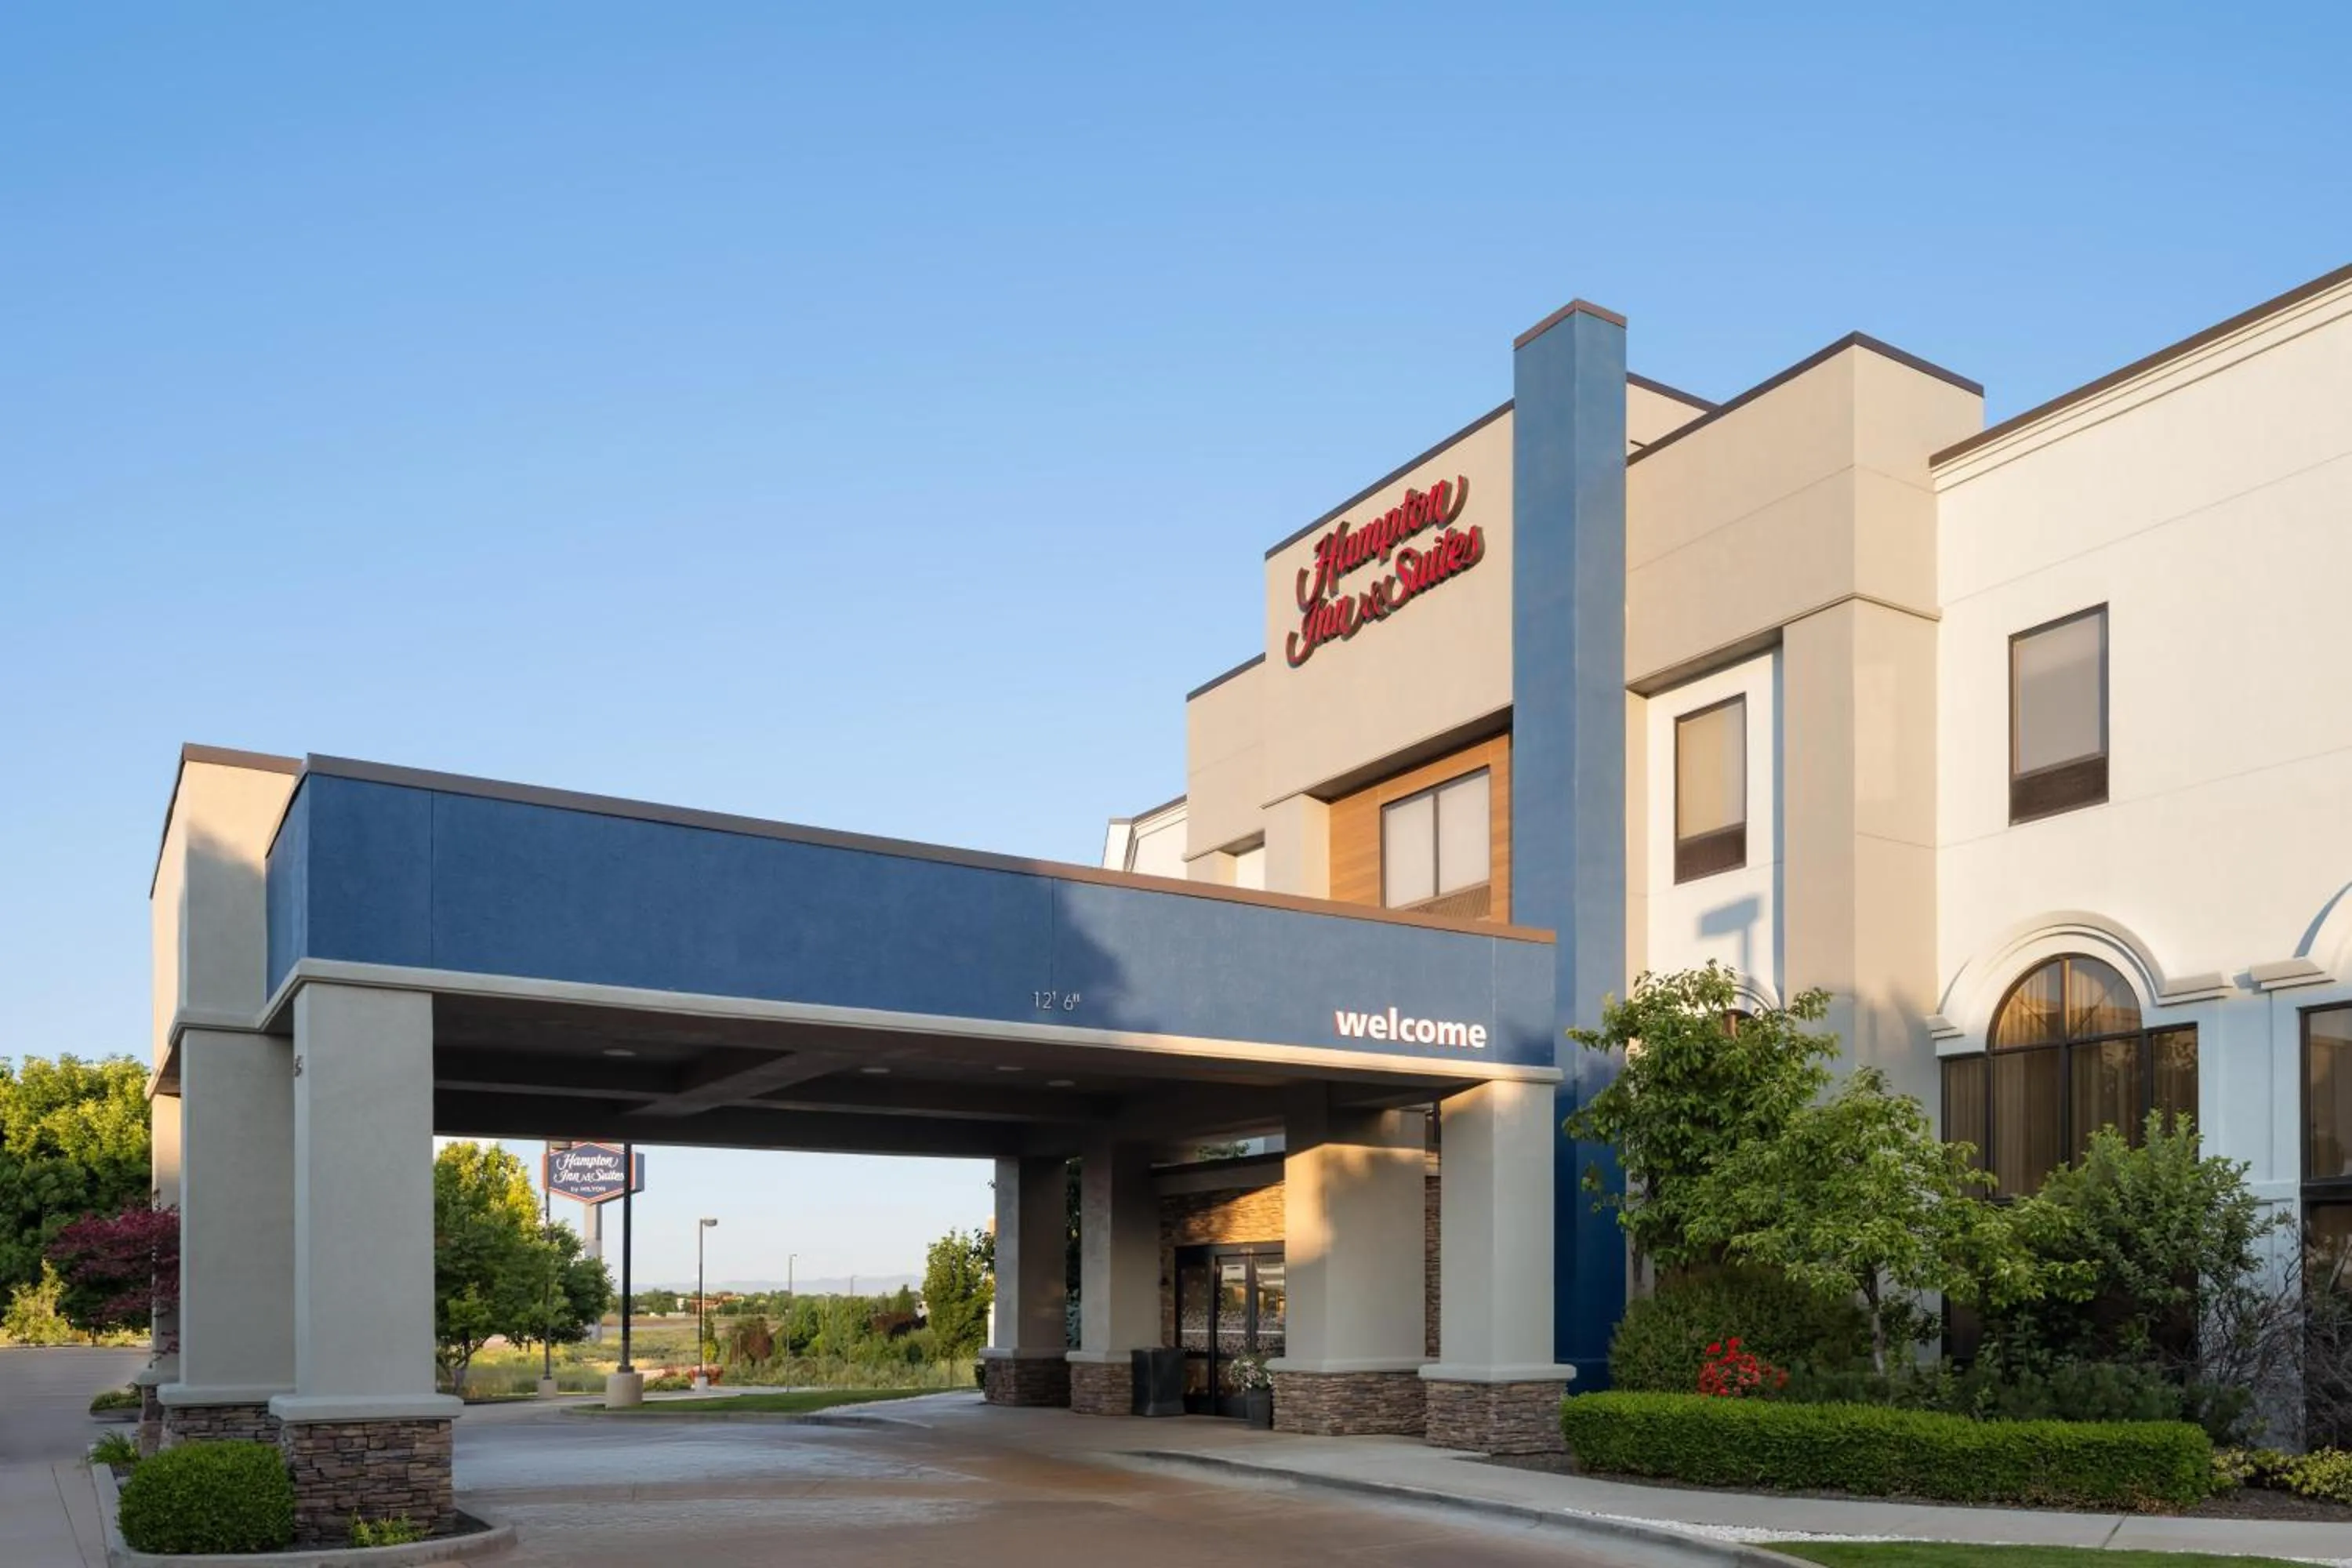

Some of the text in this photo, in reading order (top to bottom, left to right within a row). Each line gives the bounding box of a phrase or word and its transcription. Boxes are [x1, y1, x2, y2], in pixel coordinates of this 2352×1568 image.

[1296, 474, 1469, 613] Hampton
[1285, 524, 1486, 669] Inn & Suites
[1335, 1007, 1487, 1048] welcome
[553, 1169, 583, 1183] Inn
[591, 1168, 625, 1182] Suites
[555, 1153, 619, 1171] Hampton
